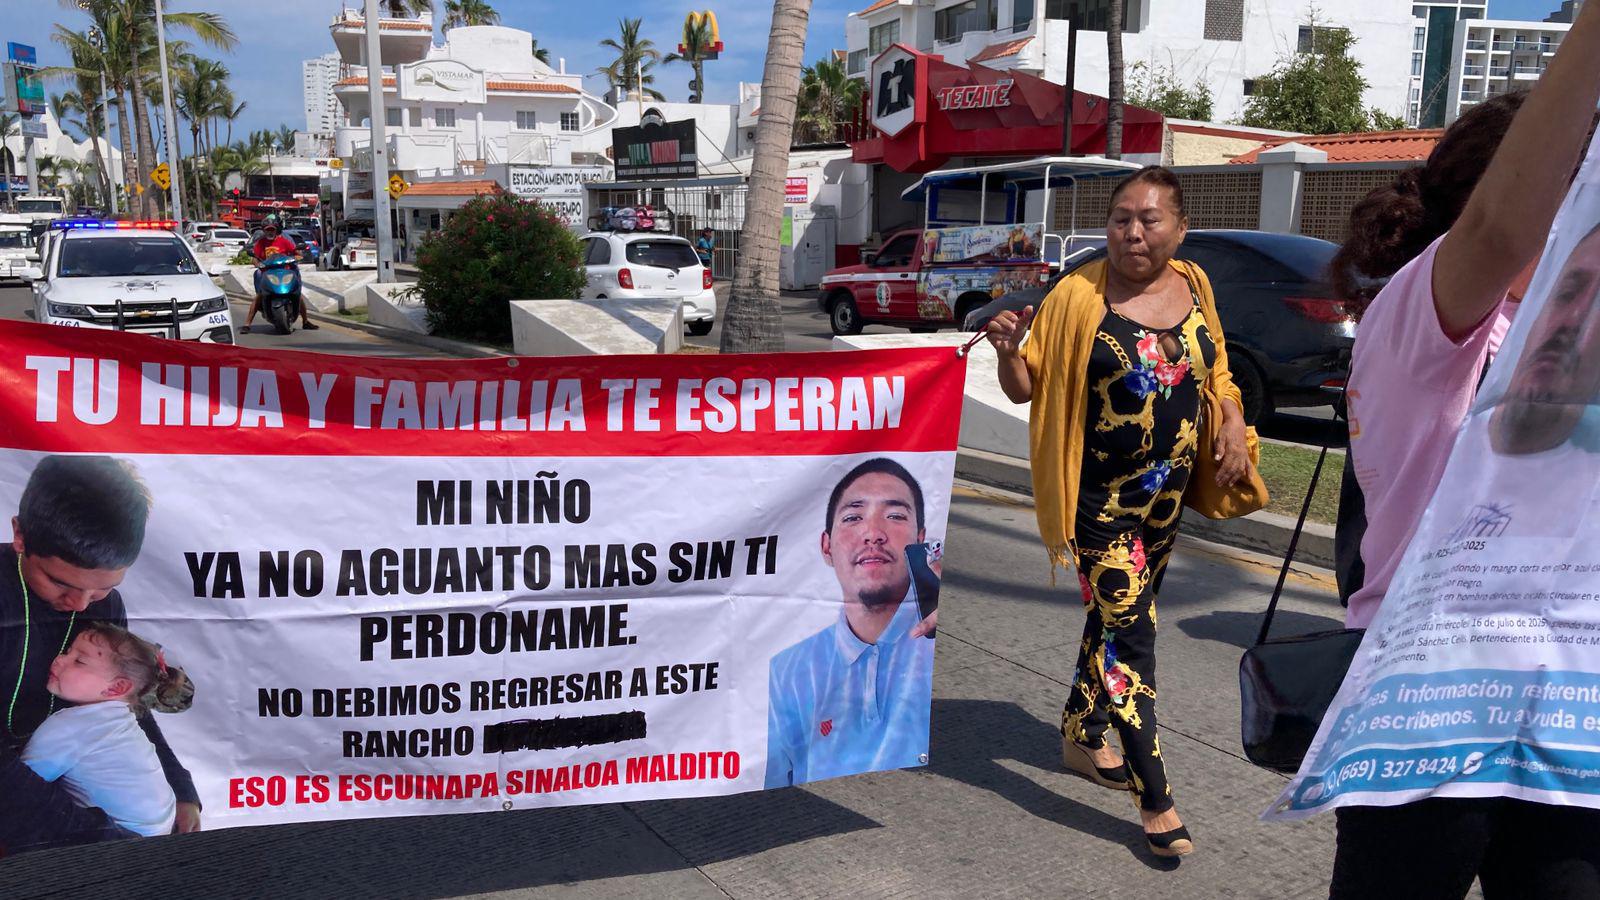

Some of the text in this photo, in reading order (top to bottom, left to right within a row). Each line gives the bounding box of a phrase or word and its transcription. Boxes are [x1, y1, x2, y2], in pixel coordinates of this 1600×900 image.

[436, 70, 474, 79] VISTAMAR
[936, 79, 1014, 110] TECATE
[512, 173, 573, 185] ESTACIONAMIENTO
[555, 201, 582, 216] TIEMPO
[208, 314, 228, 325] 46A
[25, 355, 905, 432] TU HIJA Y FAMILIA TE ESPERAN
[417, 470, 591, 525] MI NIÑO
[184, 535, 778, 598] YA NO AGUANTO MAS SIN TI
[360, 604, 637, 662] PERDONAME.
[1472, 618, 1482, 627] 16
[1485, 618, 1496, 627] de
[1516, 618, 1527, 627] de
[1470, 634, 1532, 645] perteneciente
[1576, 635, 1588, 645] de
[258, 662, 719, 718] NO DEBIMOS REGRESAR A ESTE
[1398, 680, 1512, 703] información
[1487, 707, 1511, 724] Tu
[343, 726, 474, 758] RANCHO
[229, 751, 740, 808] ESO ES ESCUINAPA SINALOA MALDITO
[1336, 758, 1376, 788] (669)
[1381, 760, 1414, 778] 327
[1416, 757, 1457, 775] 8424
